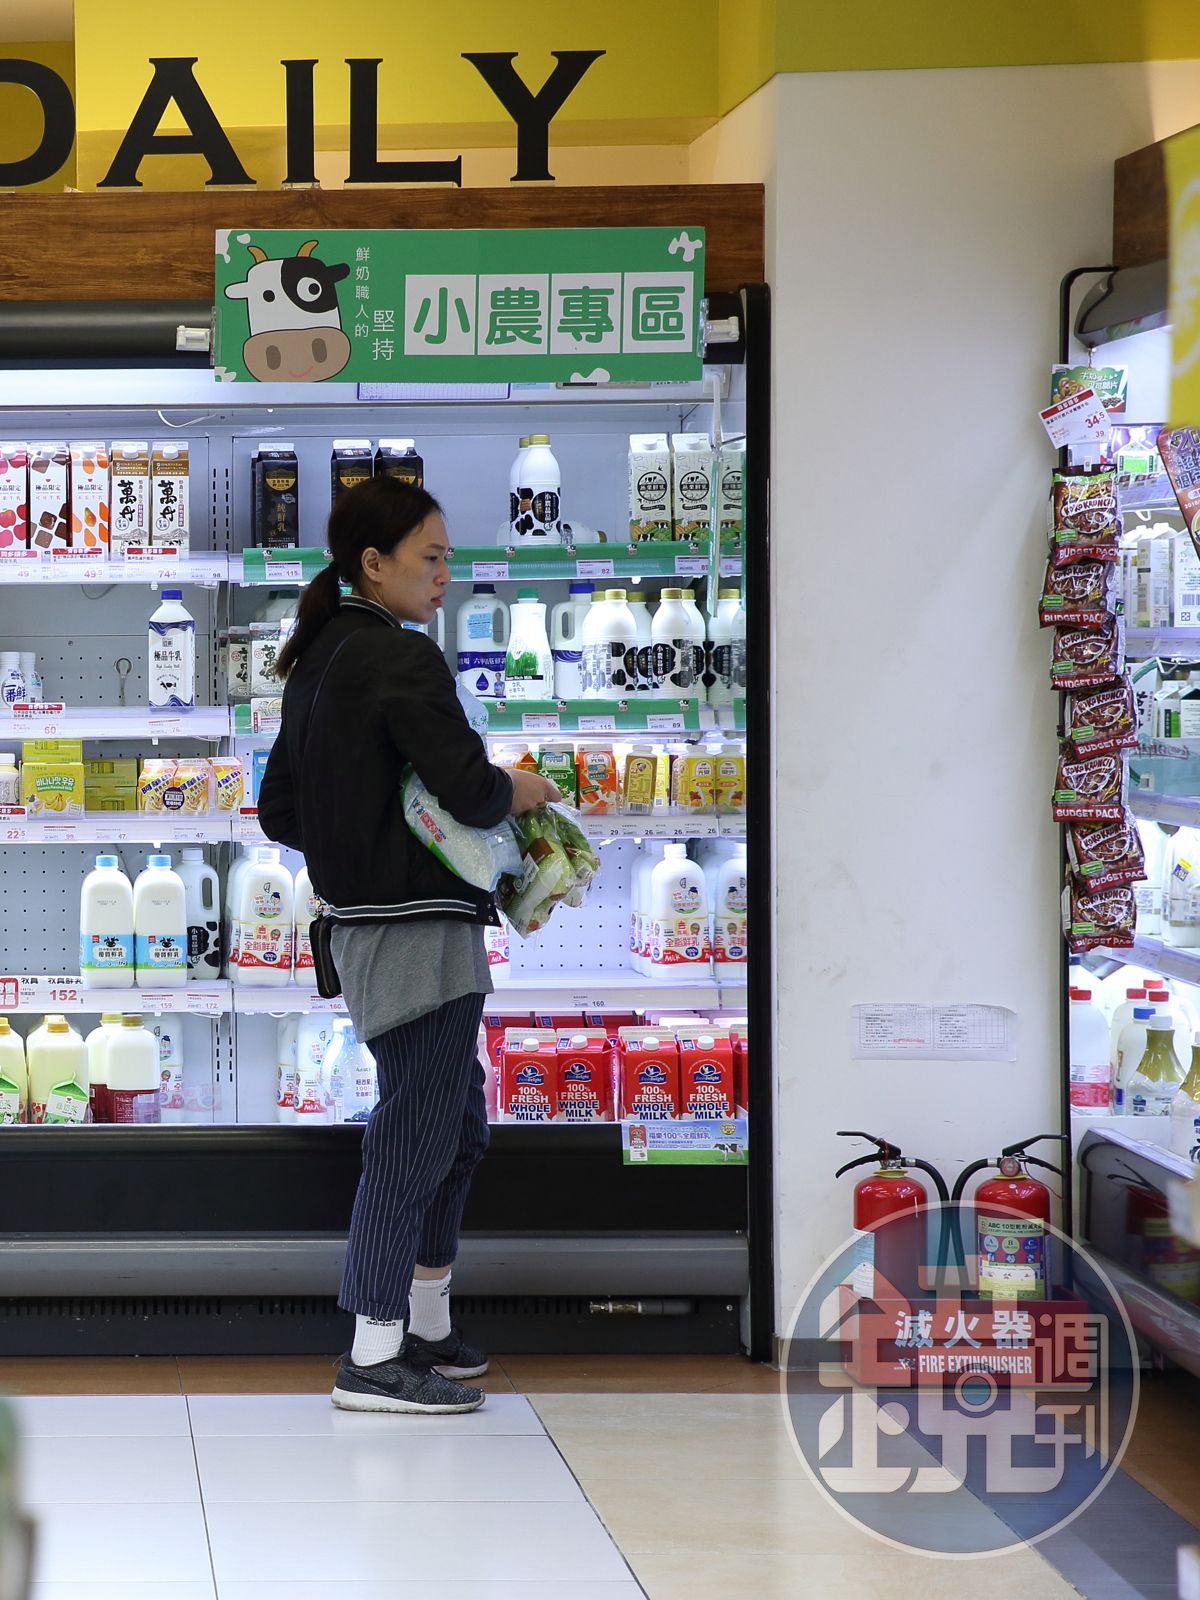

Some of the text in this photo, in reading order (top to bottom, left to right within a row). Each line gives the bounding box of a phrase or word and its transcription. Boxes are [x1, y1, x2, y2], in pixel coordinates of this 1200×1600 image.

[354, 246, 371, 339] 鮮奶職人的
[413, 286, 687, 345] 小農專區
[372, 309, 395, 361] 堅持
[1060, 548, 1094, 559] BUDGET
[1044, 614, 1080, 623] BUDGET
[1055, 678, 1095, 688] BUDGET
[1078, 741, 1115, 755] BUDGET
[1056, 808, 1094, 818] BUDGET
[1090, 874, 1123, 888] BUDGET
[1077, 937, 1112, 947] BUDGET
[49, 989, 77, 1001] 152
[518, 1086, 543, 1095] 100%
[566, 1083, 591, 1092] 100%
[641, 1085, 666, 1094] 100%
[695, 1085, 721, 1094] 100%
[511, 1094, 549, 1104] FRESH
[560, 1091, 597, 1100] FRESH
[634, 1094, 672, 1103] FRESH
[689, 1093, 727, 1102] FRESH
[509, 1103, 551, 1113] WHOLE
[559, 1100, 600, 1109] WHOLE
[632, 1103, 674, 1112] WHOLE
[687, 1102, 729, 1112] WHOLE
[515, 1112, 545, 1121] MILK
[565, 1109, 593, 1118] MILK
[639, 1111, 668, 1120] MILK
[694, 1111, 724, 1119] MILK
[894, 1309, 1032, 1350] 滅火器
[919, 1355, 1033, 1374] FIRE EXTINGUISHER
